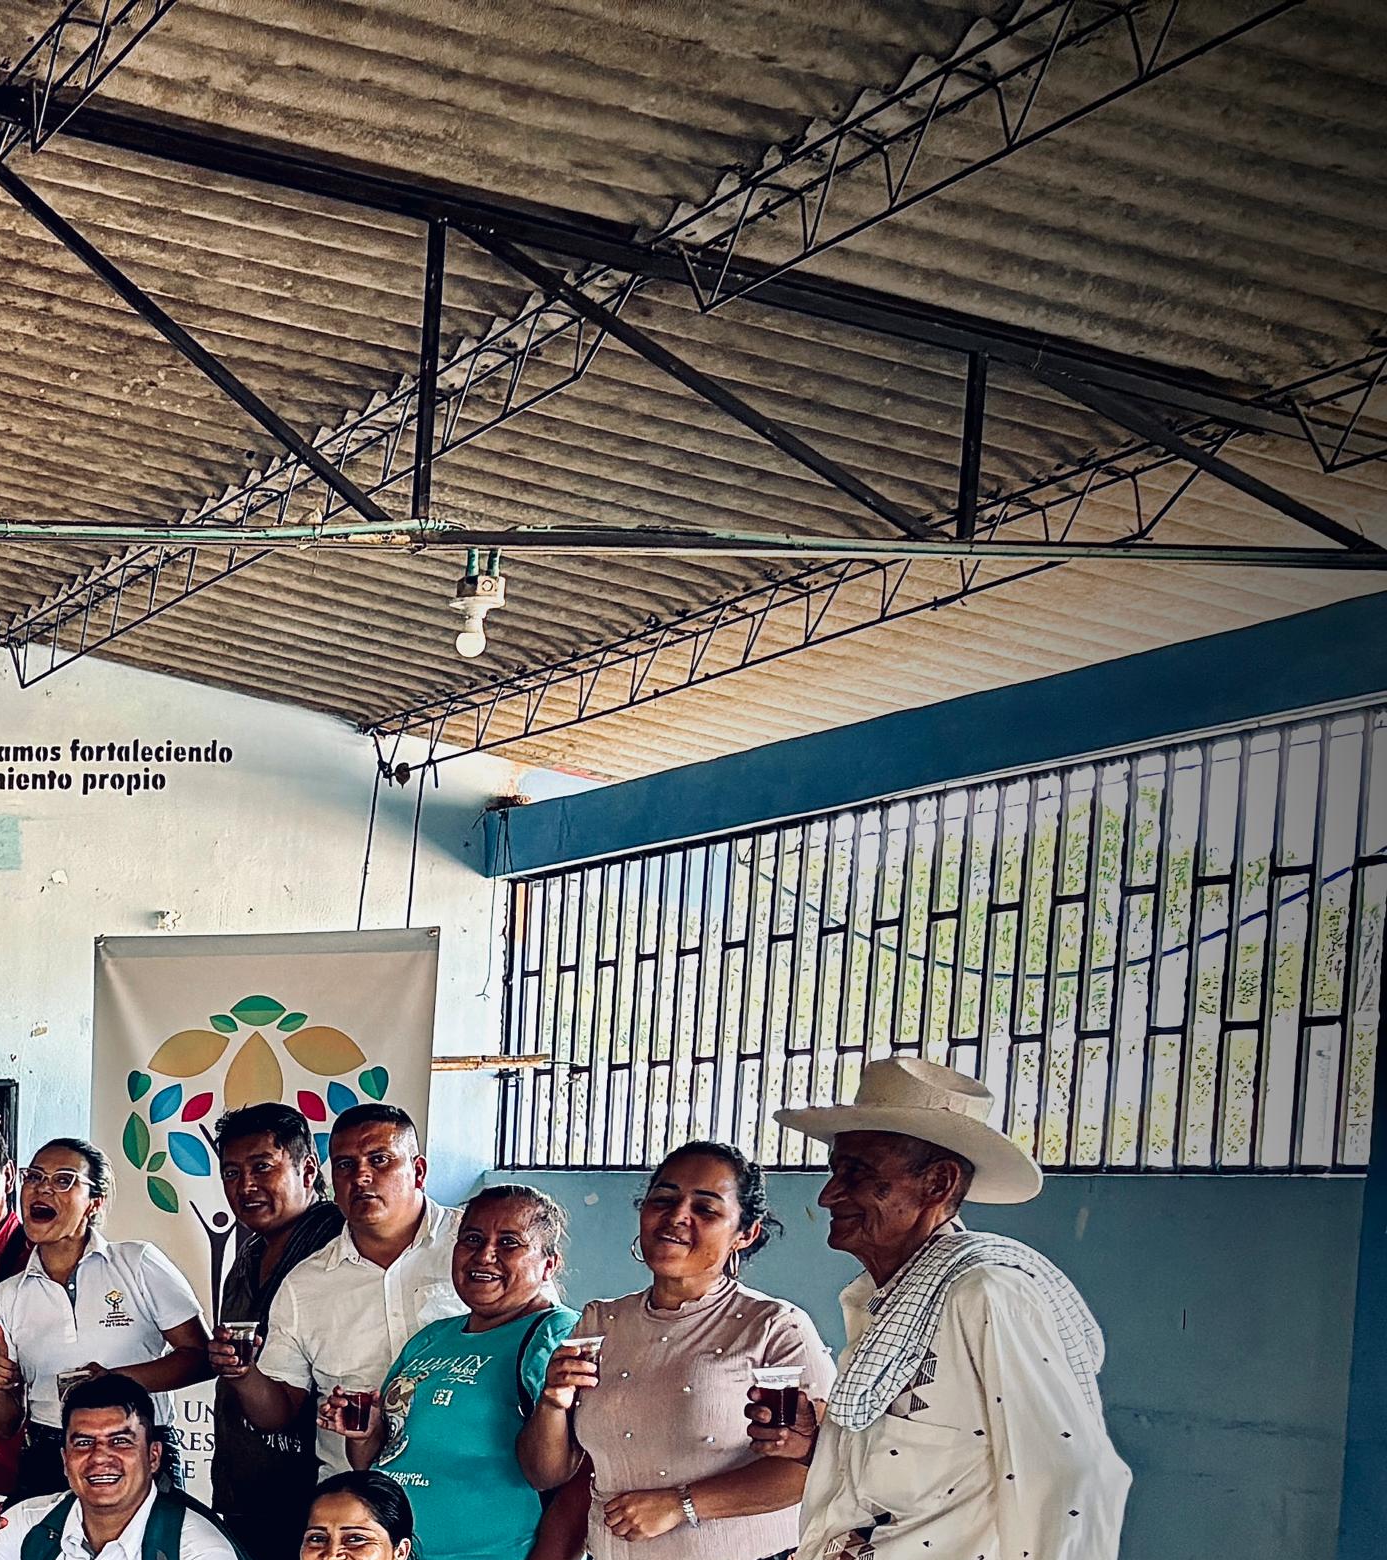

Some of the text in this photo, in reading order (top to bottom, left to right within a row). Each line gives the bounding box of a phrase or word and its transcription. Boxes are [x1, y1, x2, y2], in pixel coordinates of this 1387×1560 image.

[70, 739, 233, 763] fortaleciendo
[82, 767, 166, 796] propio
[183, 1400, 214, 1423] UN
